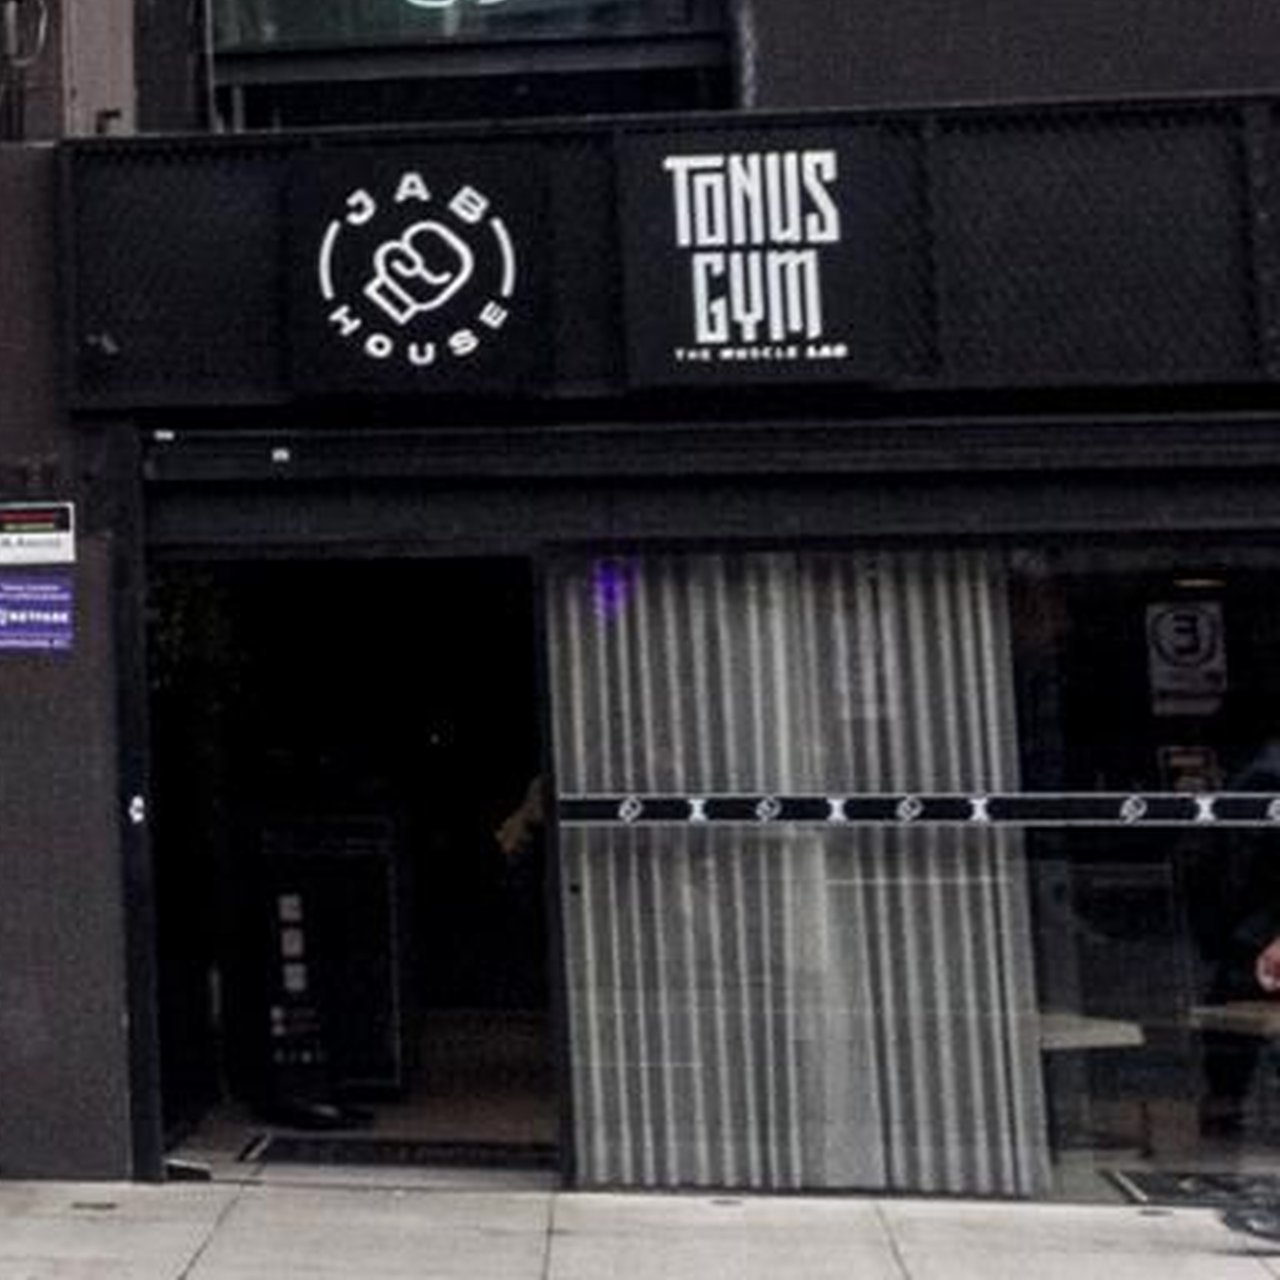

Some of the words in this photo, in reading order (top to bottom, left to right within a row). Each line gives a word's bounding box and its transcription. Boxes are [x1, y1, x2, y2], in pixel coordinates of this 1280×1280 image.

[345, 172, 489, 225] JAB
[663, 150, 839, 246] TONUS
[329, 300, 509, 365] HOUSE
[692, 248, 823, 343] GYM
